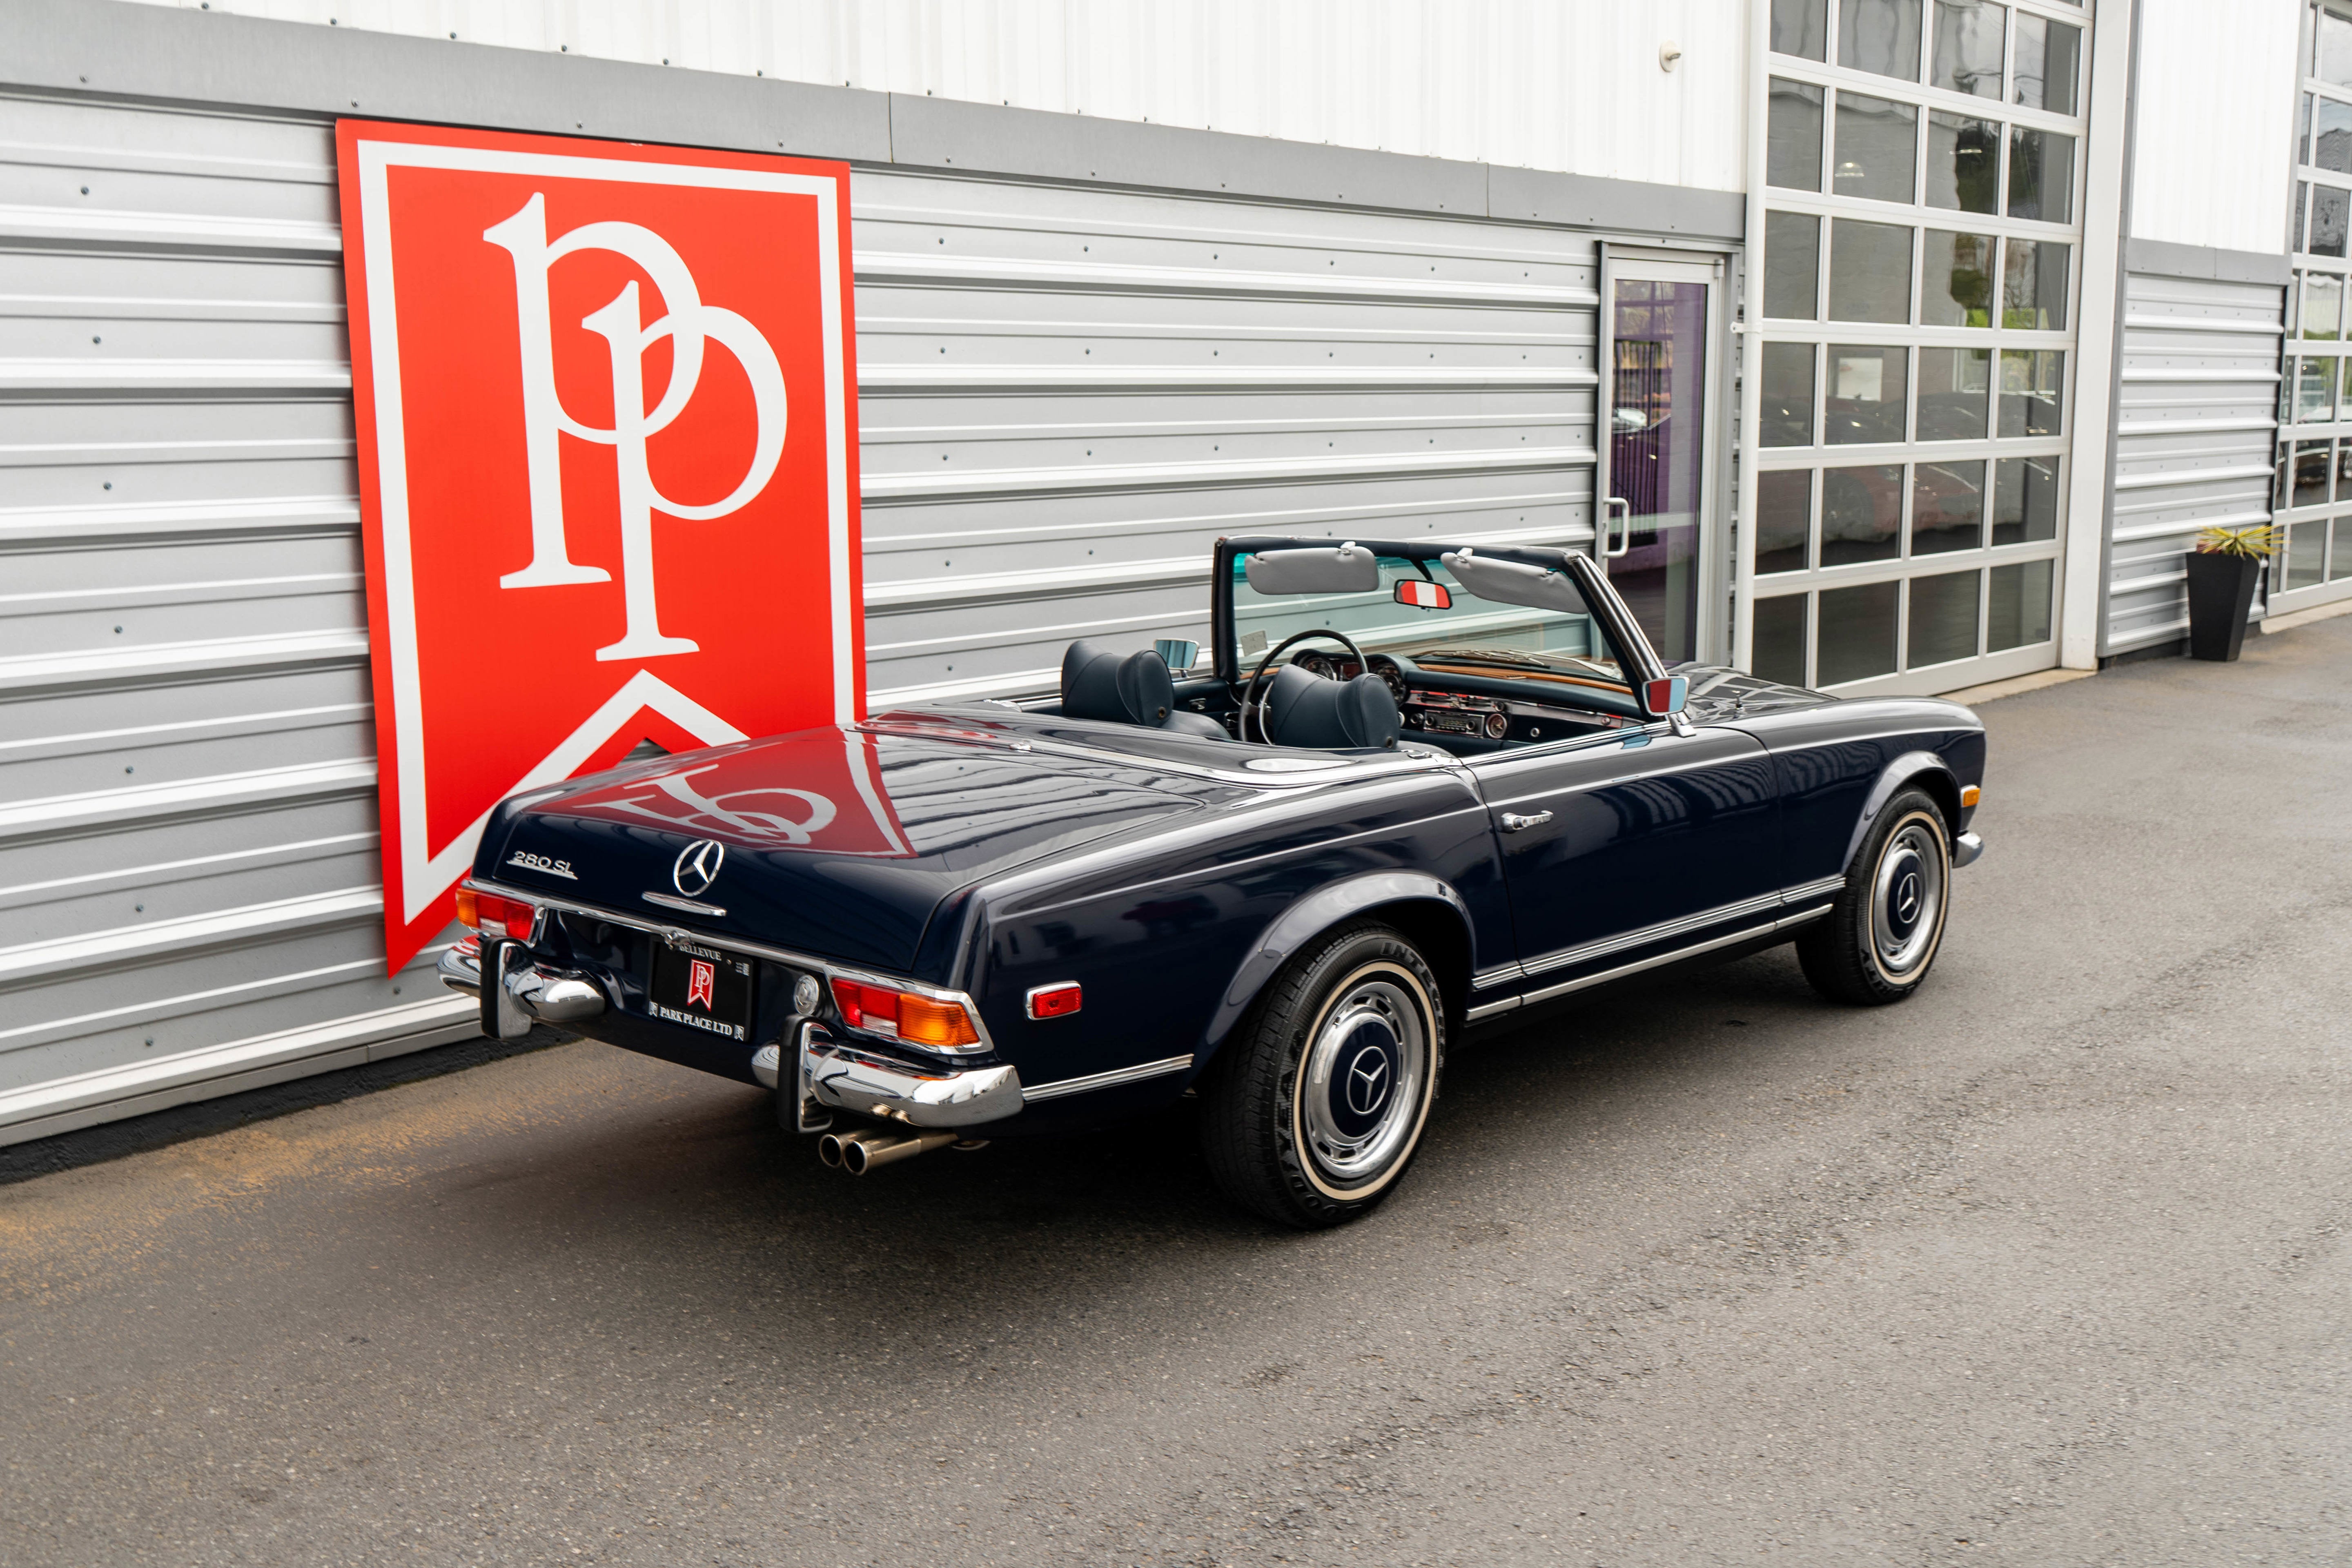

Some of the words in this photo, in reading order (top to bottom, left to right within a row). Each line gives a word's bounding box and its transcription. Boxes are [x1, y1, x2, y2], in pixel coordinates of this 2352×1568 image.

[512, 851, 552, 868] 280
[552, 860, 574, 875] SL
[679, 944, 722, 961] BELLEVUE
[659, 1006, 683, 1022] PARK
[683, 1012, 713, 1031] PLACE
[712, 1021, 733, 1036] LTD
